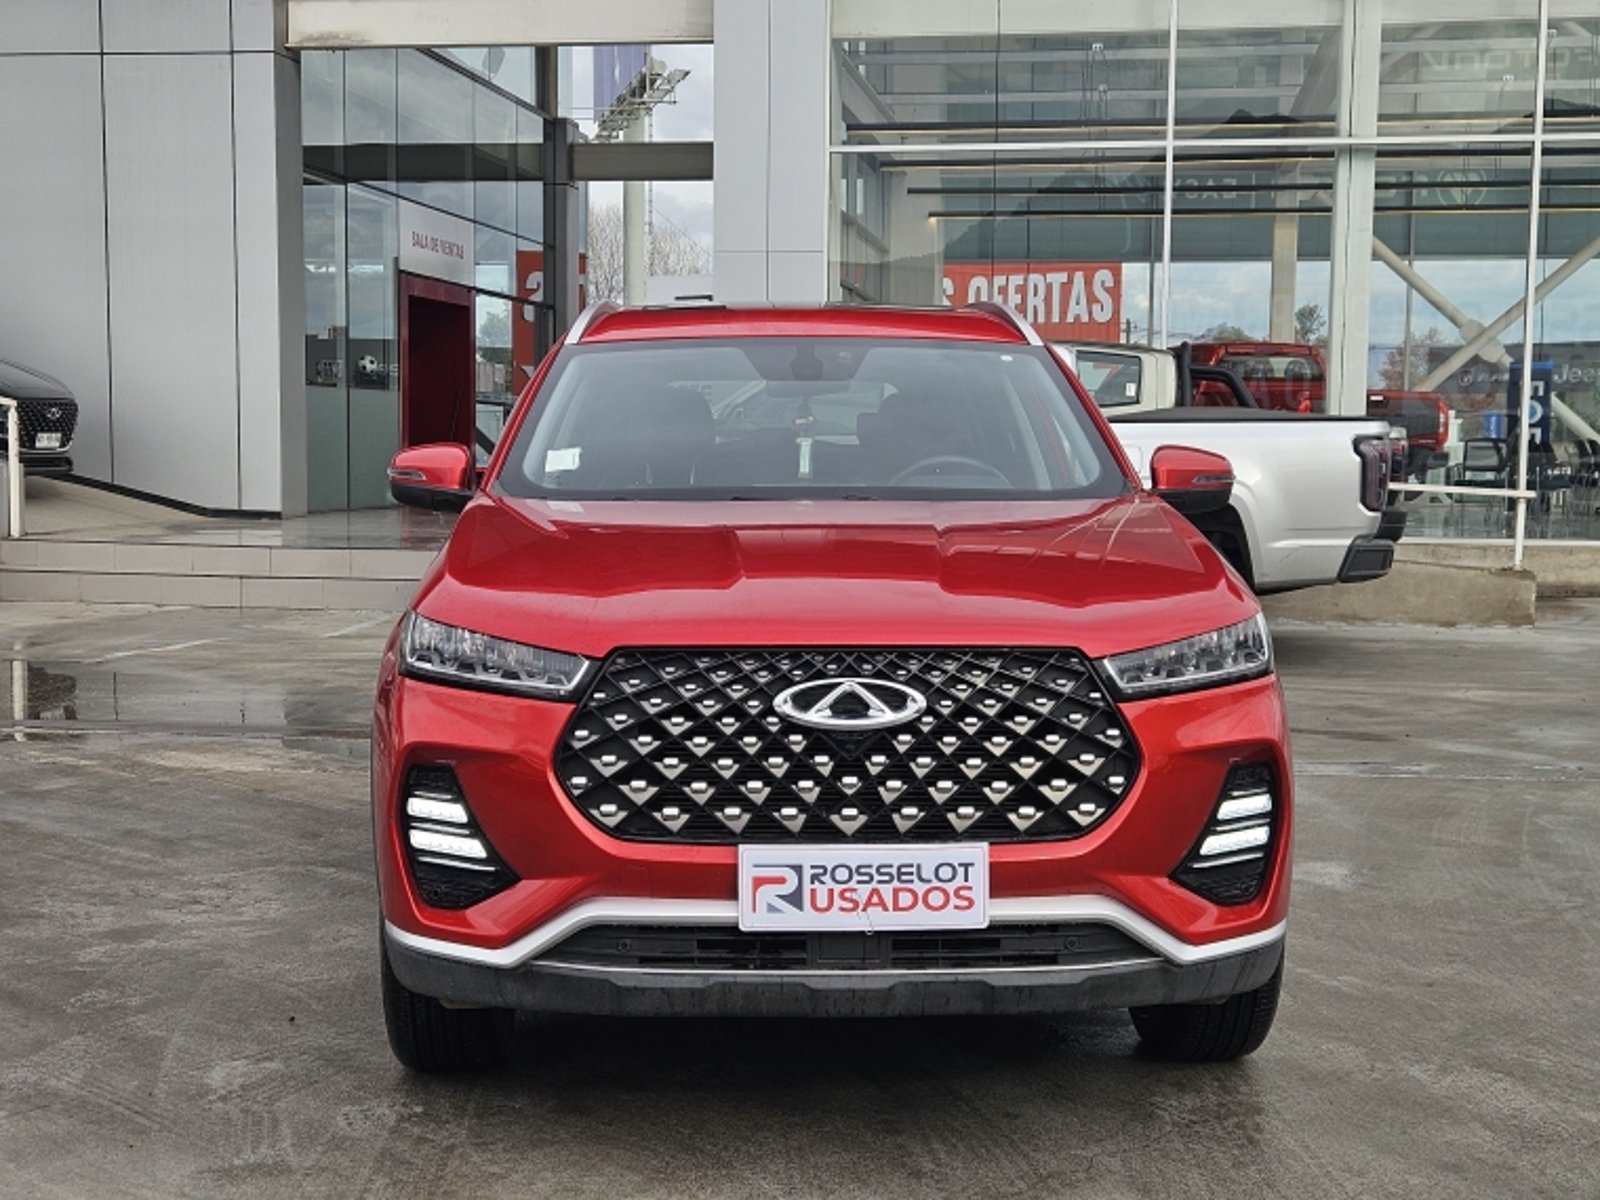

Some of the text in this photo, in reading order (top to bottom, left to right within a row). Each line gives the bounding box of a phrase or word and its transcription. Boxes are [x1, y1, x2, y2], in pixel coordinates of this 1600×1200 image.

[411, 230, 464, 260] SALA DE VENTAS
[968, 269, 1114, 324] OFERTAS
[809, 862, 975, 885] ROSSELOT
[809, 885, 976, 913] USADOS
